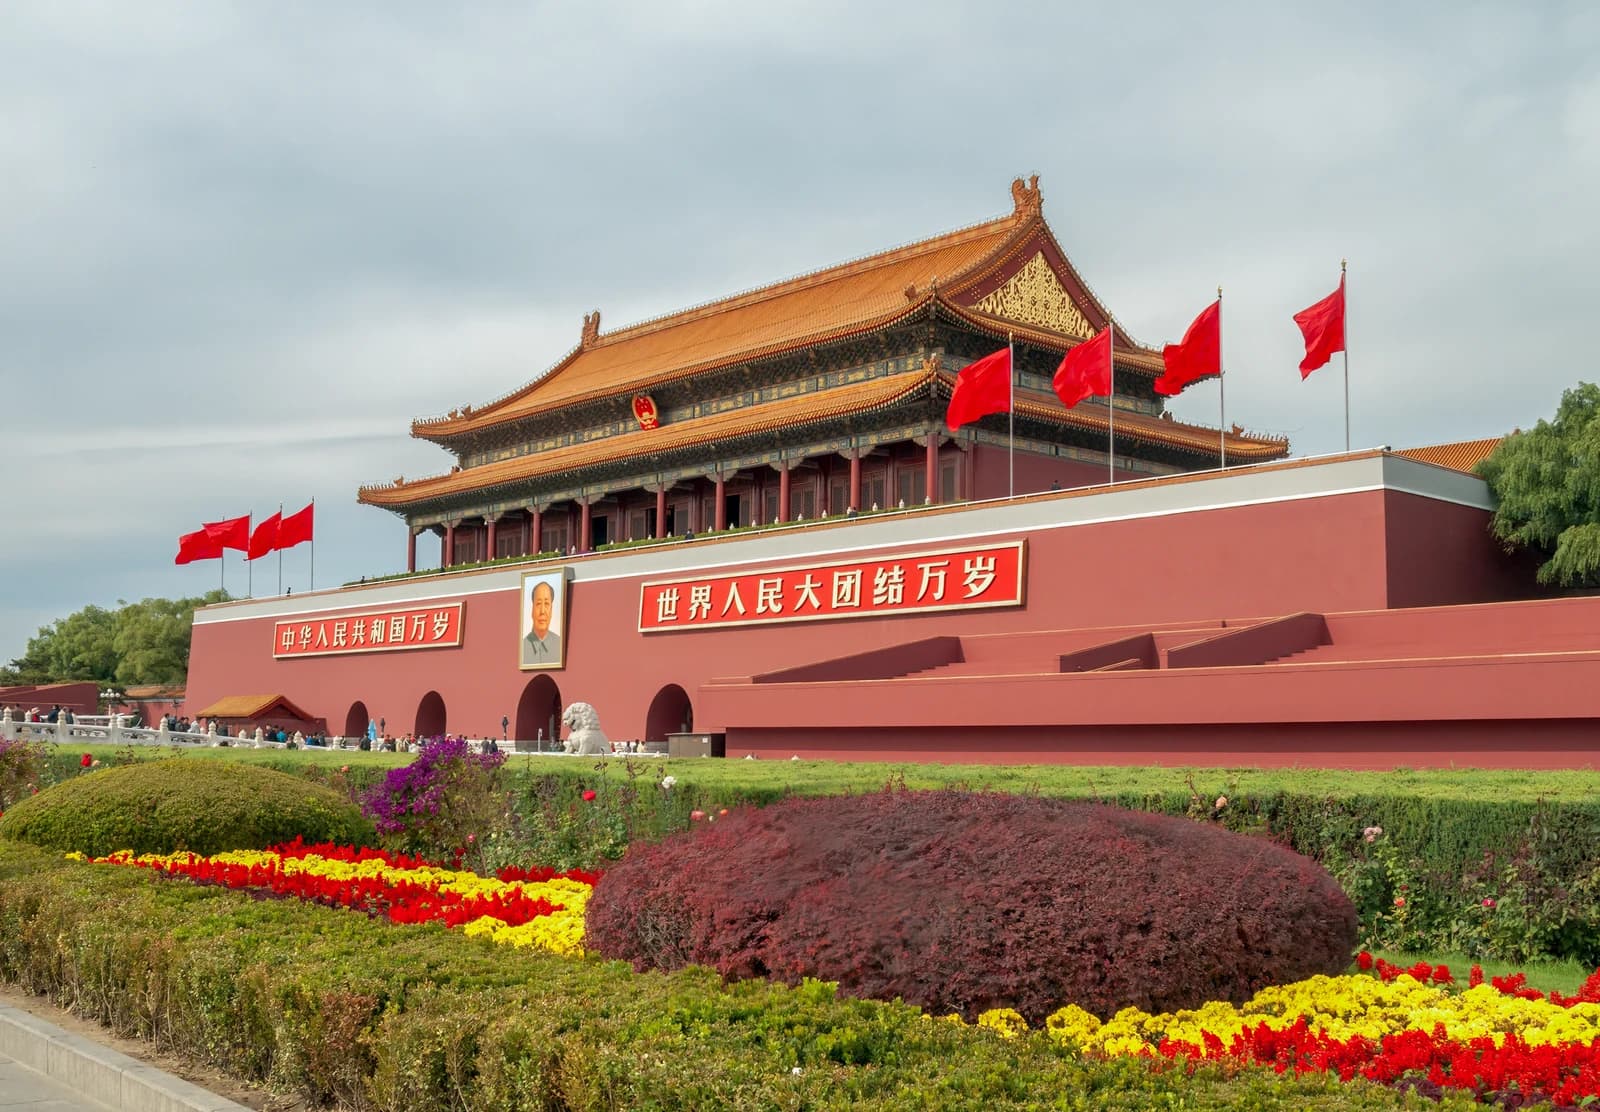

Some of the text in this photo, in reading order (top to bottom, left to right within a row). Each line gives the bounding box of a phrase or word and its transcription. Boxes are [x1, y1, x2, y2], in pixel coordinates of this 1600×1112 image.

[656, 556, 996, 622] 世界人民大团结万岁
[282, 611, 449, 650] 中华人民共和国万岁
